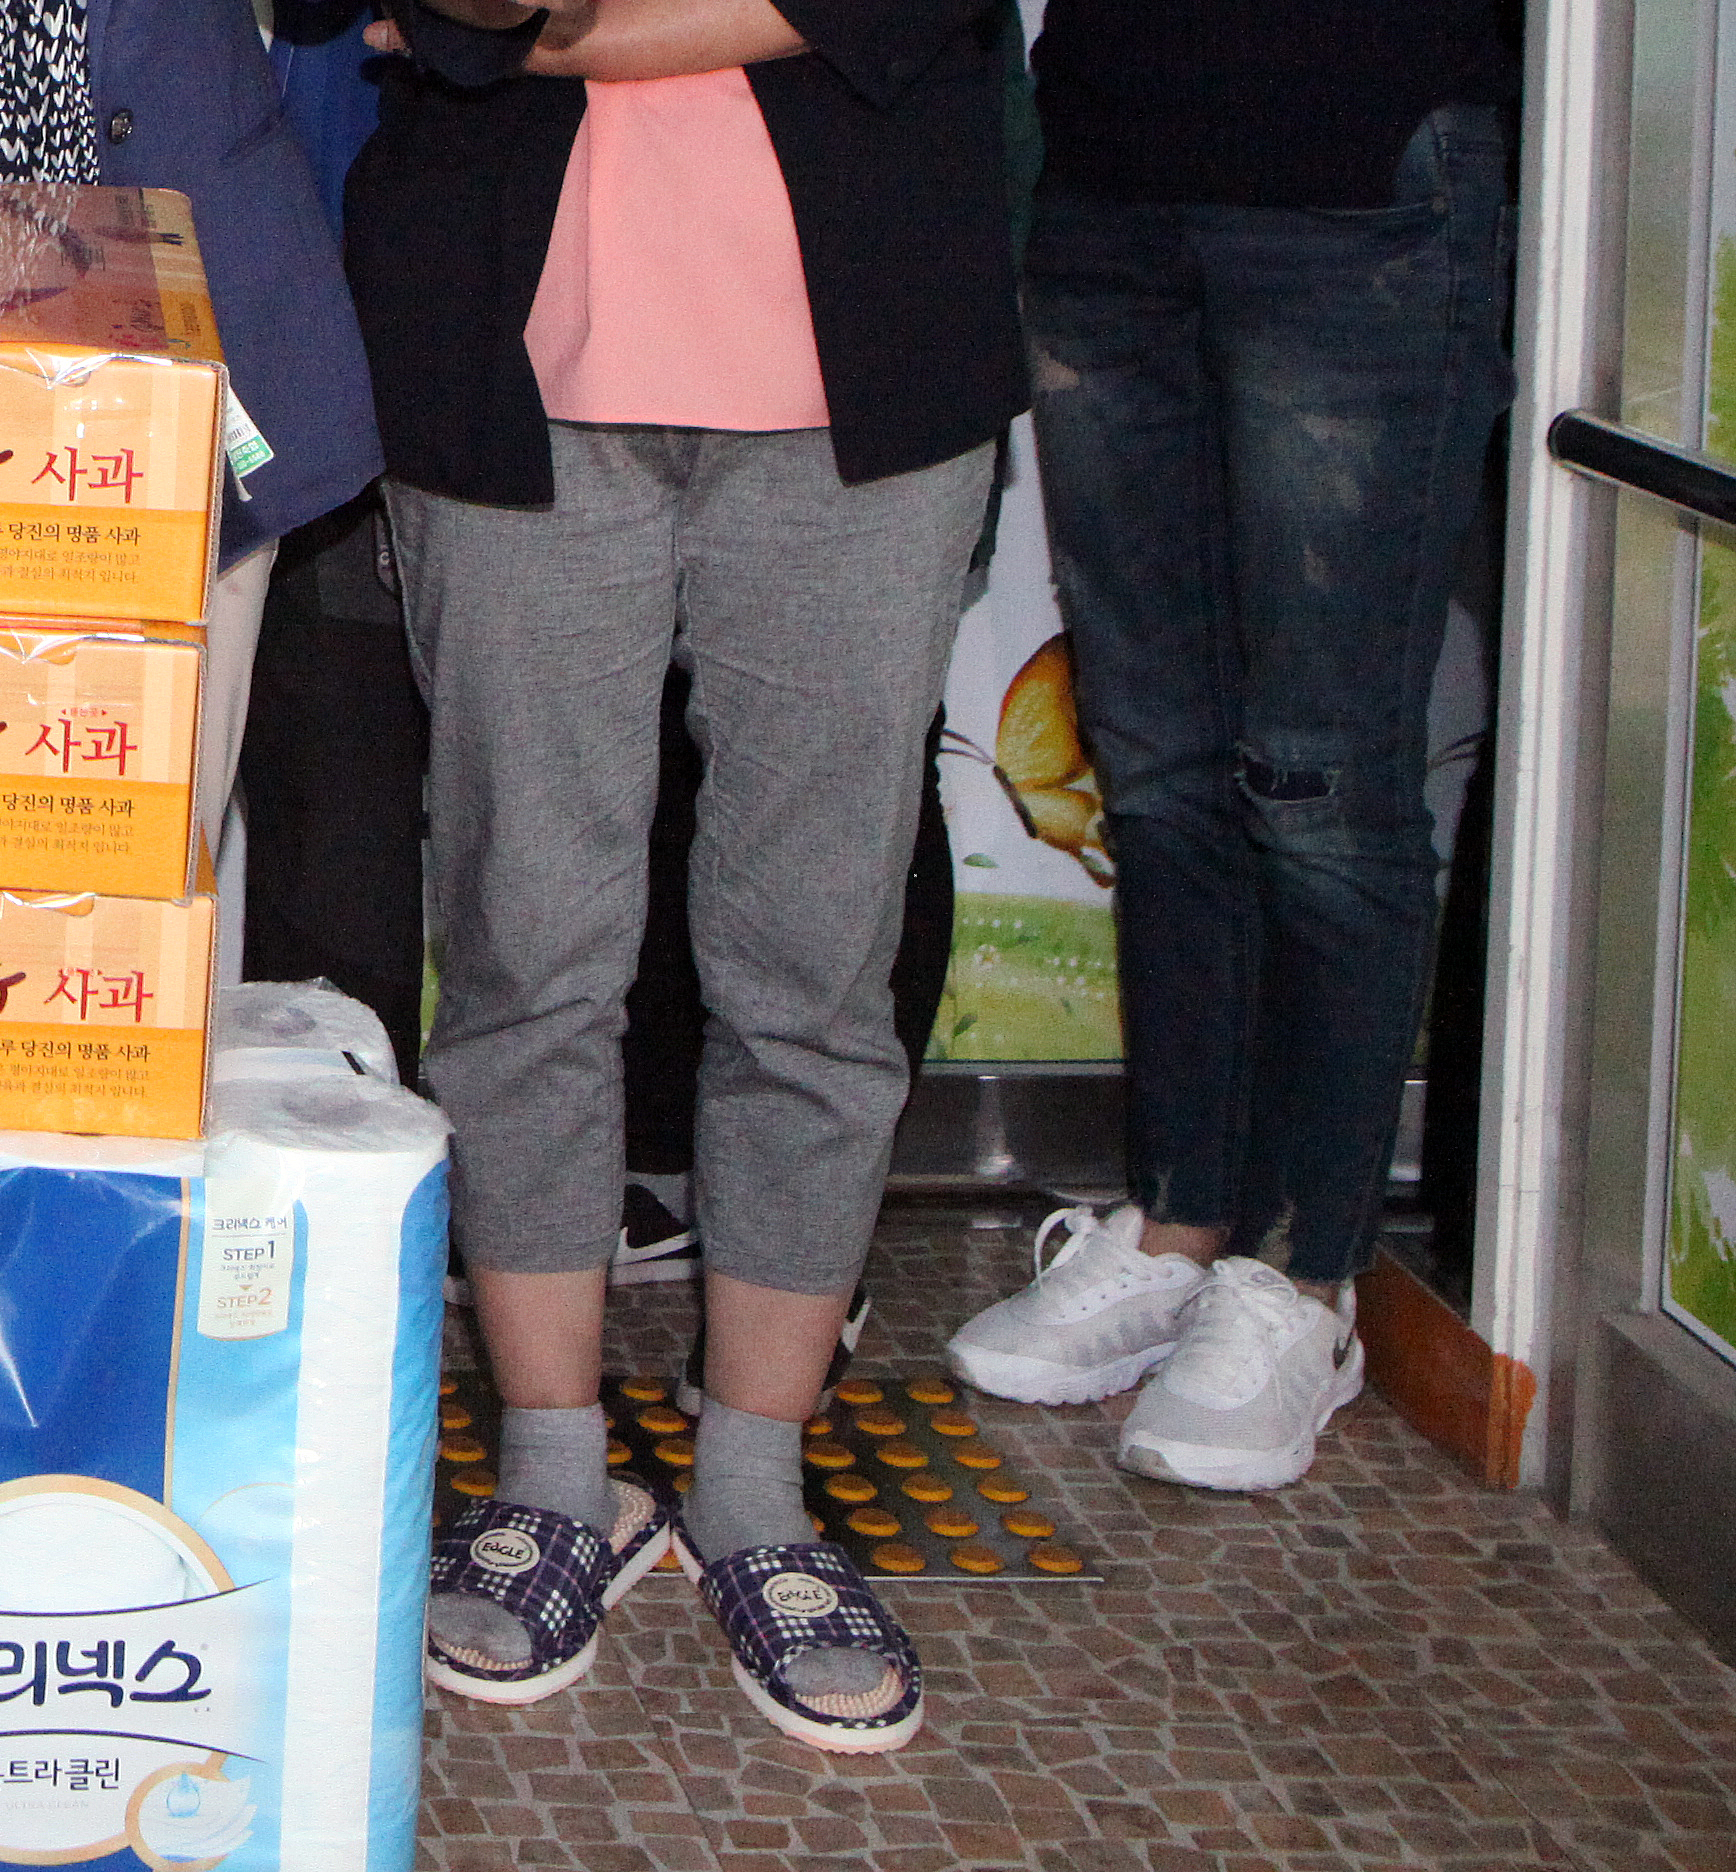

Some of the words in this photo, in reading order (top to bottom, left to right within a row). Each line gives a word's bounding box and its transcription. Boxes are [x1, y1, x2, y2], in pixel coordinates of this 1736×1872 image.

[31, 446, 144, 504] 사과
[9, 522, 60, 543] 당진의
[67, 525, 101, 544] 명품
[106, 526, 141, 546] 사과
[25, 718, 138, 776] 사과
[3, 793, 54, 814] 당진의
[61, 796, 95, 815] 명품
[99, 798, 135, 818] 사과
[44, 968, 154, 1023] 사과
[22, 1040, 71, 1059] 당진의
[78, 1042, 111, 1061] 명품
[119, 1044, 151, 1063] 사과
